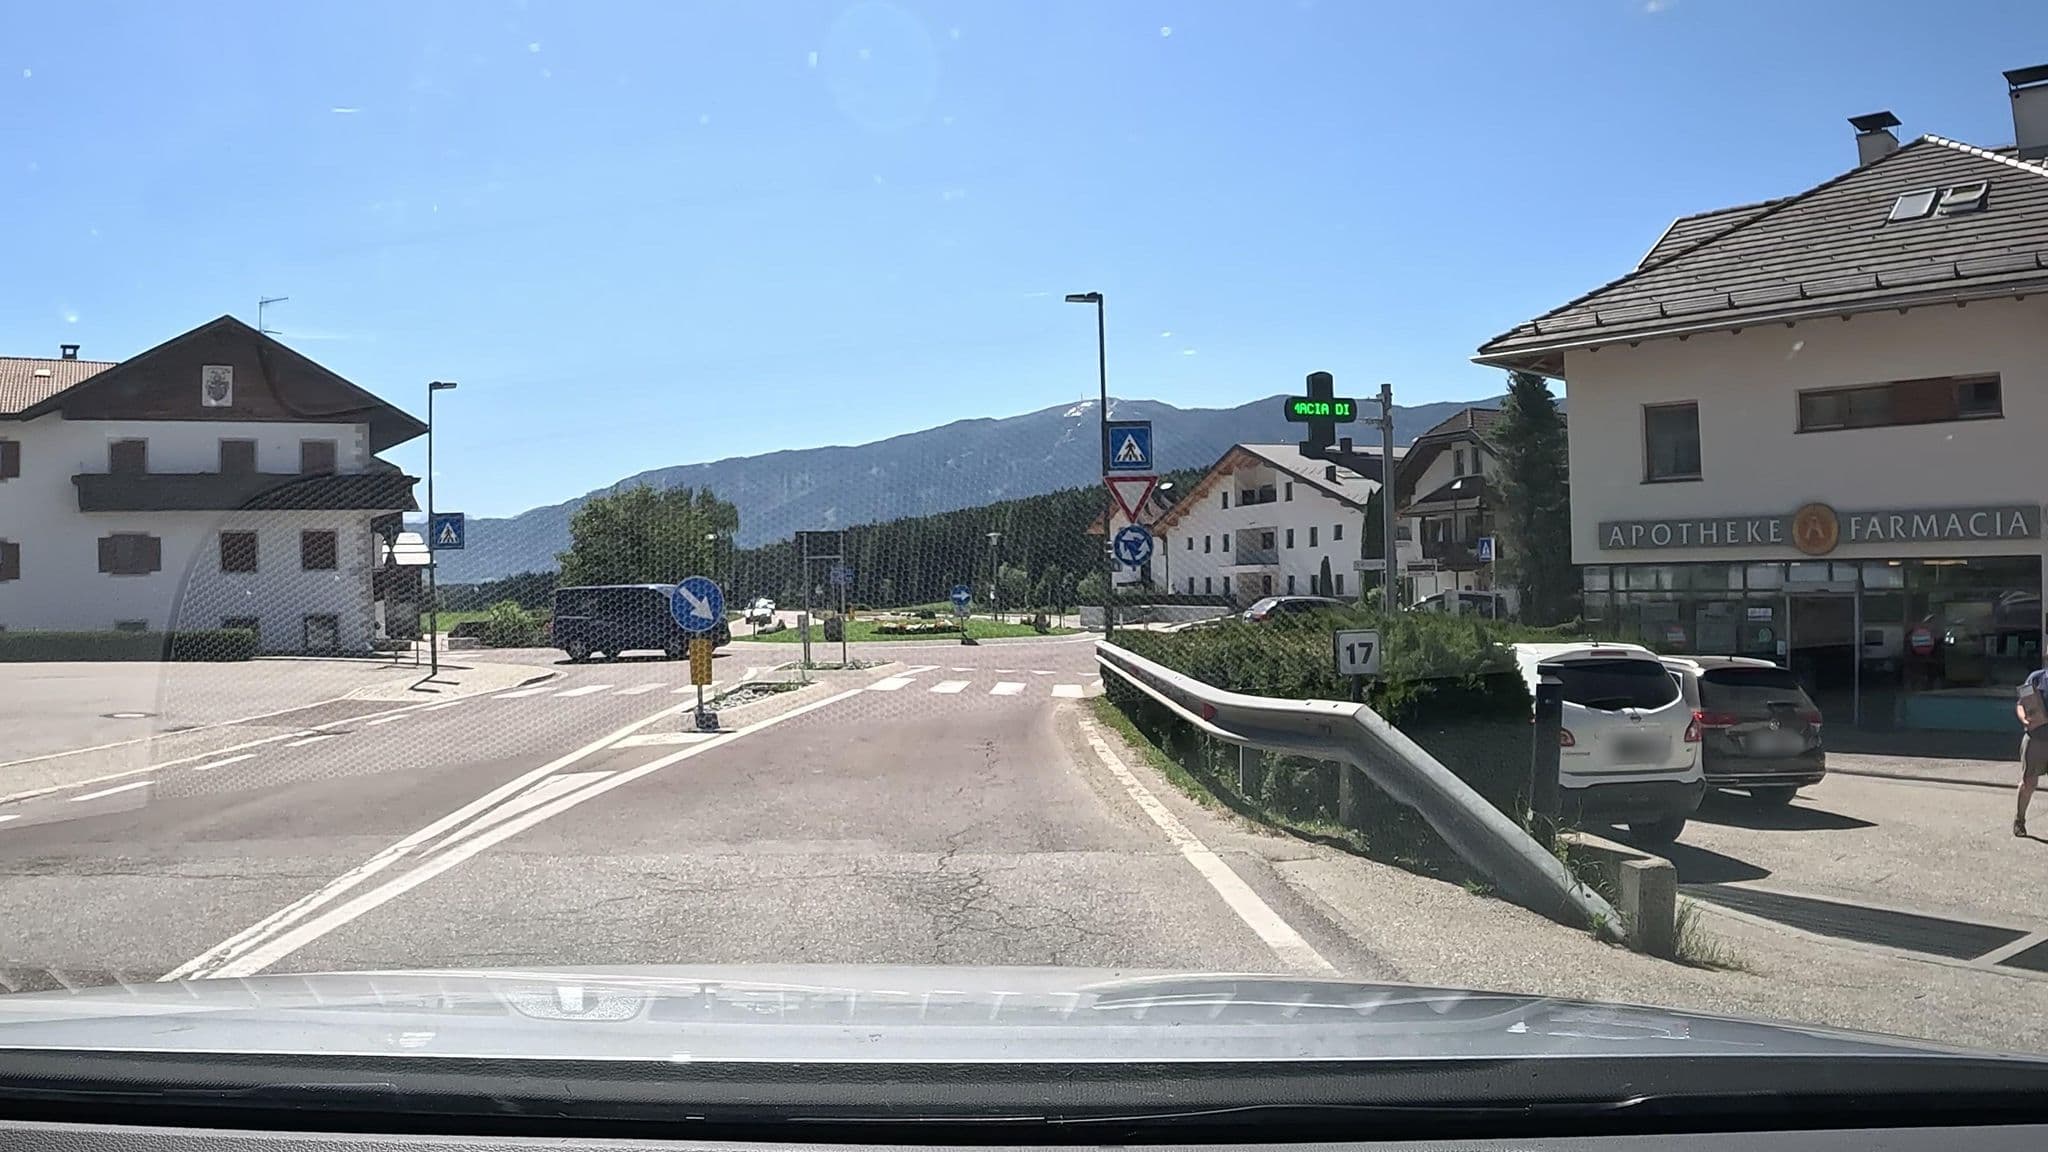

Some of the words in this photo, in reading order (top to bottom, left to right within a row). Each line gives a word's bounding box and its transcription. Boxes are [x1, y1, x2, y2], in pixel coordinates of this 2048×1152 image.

[1336, 403, 1350, 415] DI
[1608, 520, 1783, 547] APOTHEKE
[1850, 511, 2029, 541] FARMACIA
[1345, 642, 1374, 665] 17
